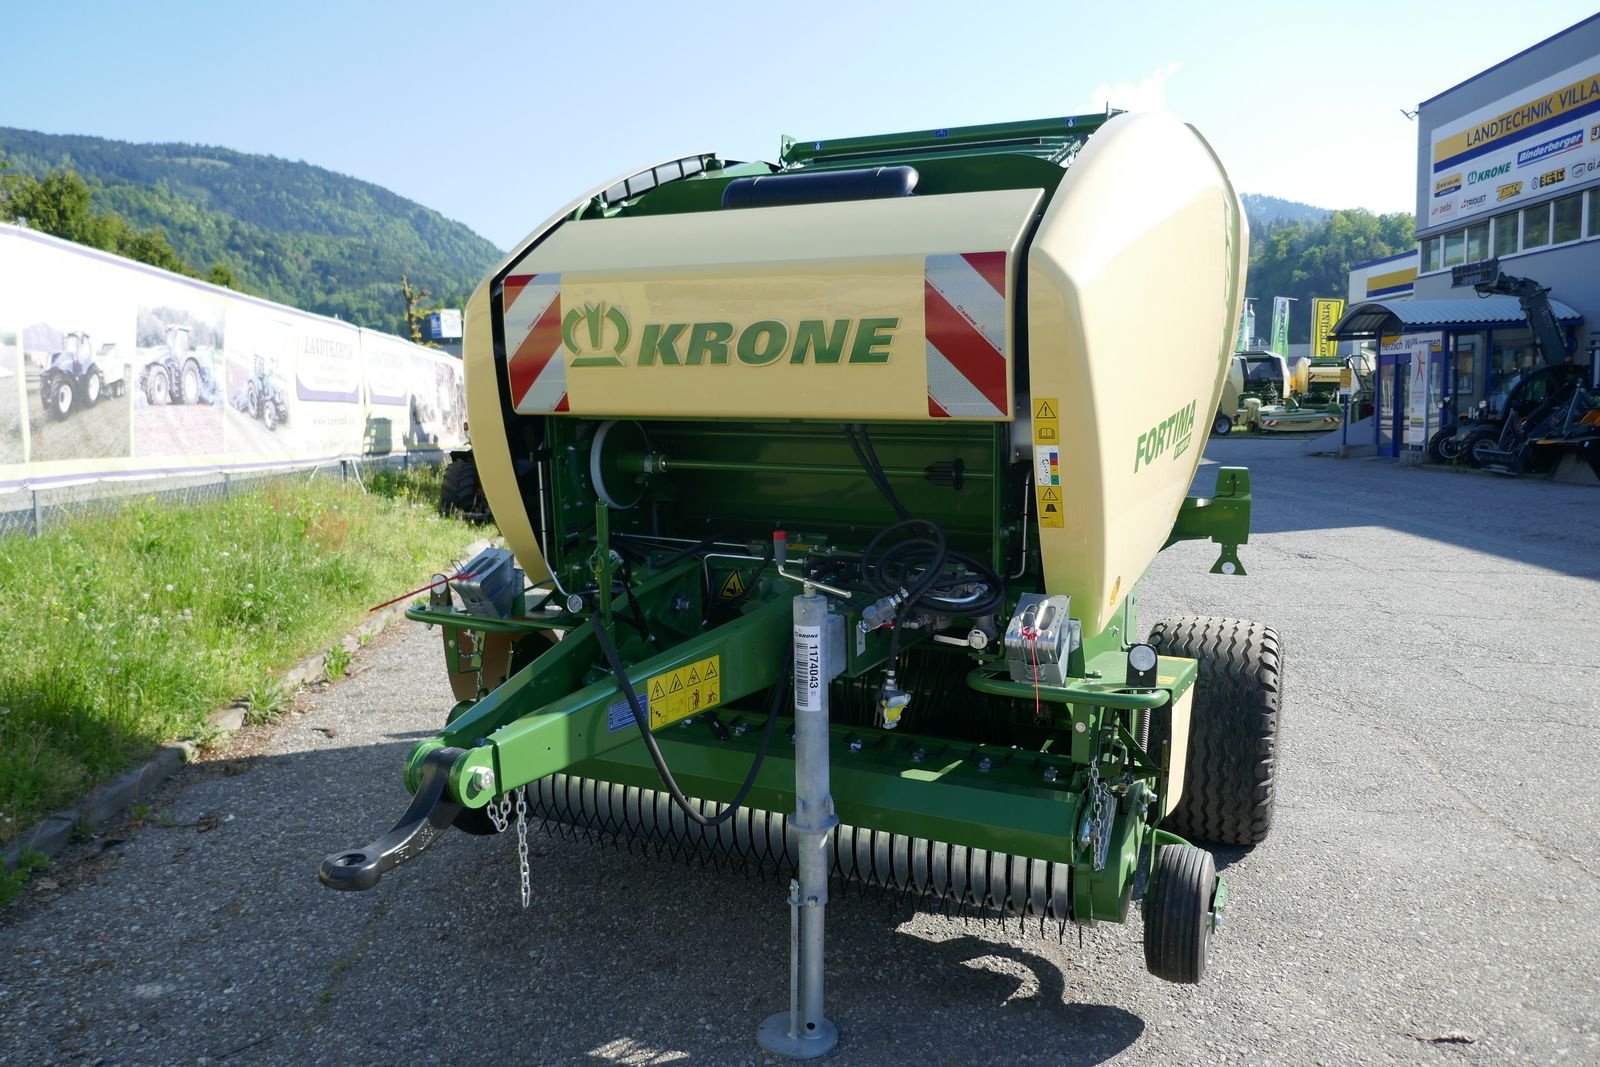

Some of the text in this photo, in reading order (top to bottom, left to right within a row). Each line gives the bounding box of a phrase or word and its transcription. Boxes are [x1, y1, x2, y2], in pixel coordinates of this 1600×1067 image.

[1466, 97, 1553, 147] LANDTECHNIK
[1519, 133, 1582, 161] Binderberger
[1477, 162, 1512, 182] KRONE
[636, 316, 901, 367] KRONE
[1134, 398, 1197, 475] FORTIMA
[809, 643, 819, 689] 1174043
